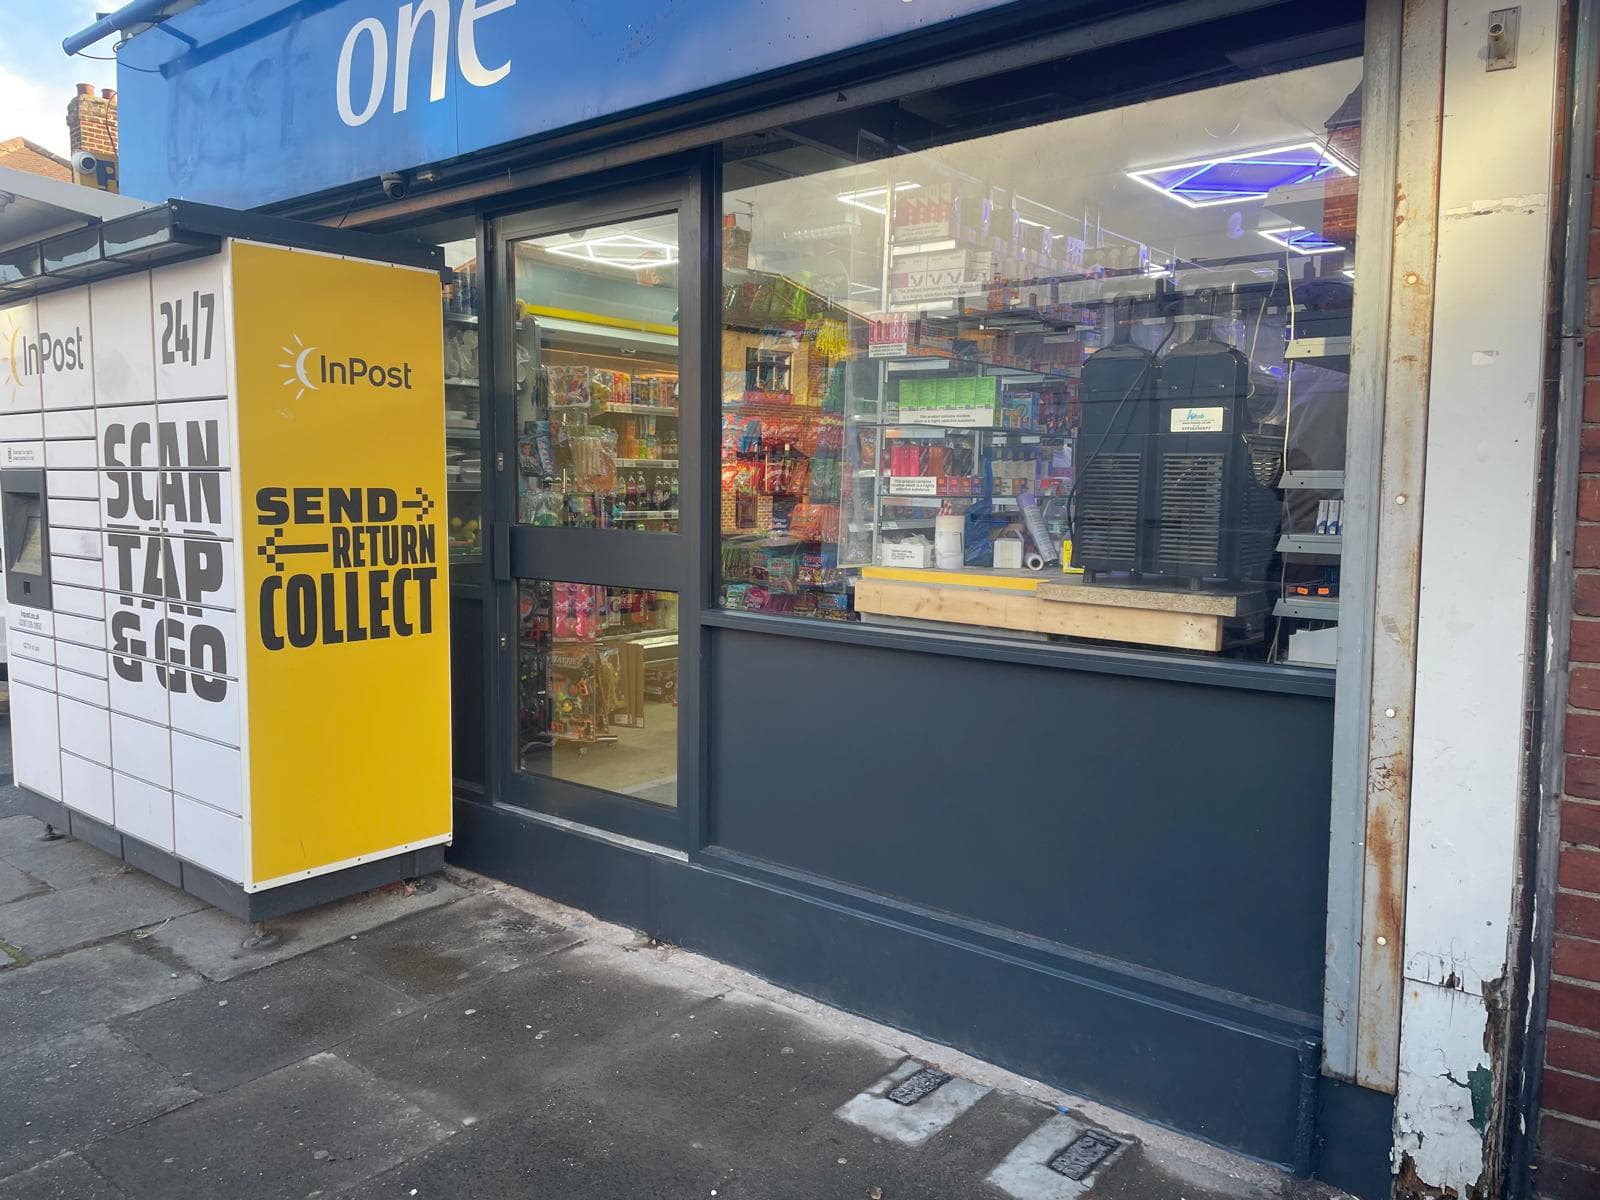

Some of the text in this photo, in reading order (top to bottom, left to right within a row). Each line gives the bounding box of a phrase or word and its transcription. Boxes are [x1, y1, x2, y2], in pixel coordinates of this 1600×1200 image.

[336, 0, 517, 127] one
[23, 326, 84, 376] InPost
[160, 290, 215, 367] 24/7
[319, 354, 412, 390] InPost
[104, 419, 222, 524] SCAN
[255, 487, 398, 526] SEND
[106, 523, 224, 618] TAP
[332, 523, 436, 569] RETURN
[259, 566, 437, 651] COLLECT
[154, 618, 228, 703] GO
